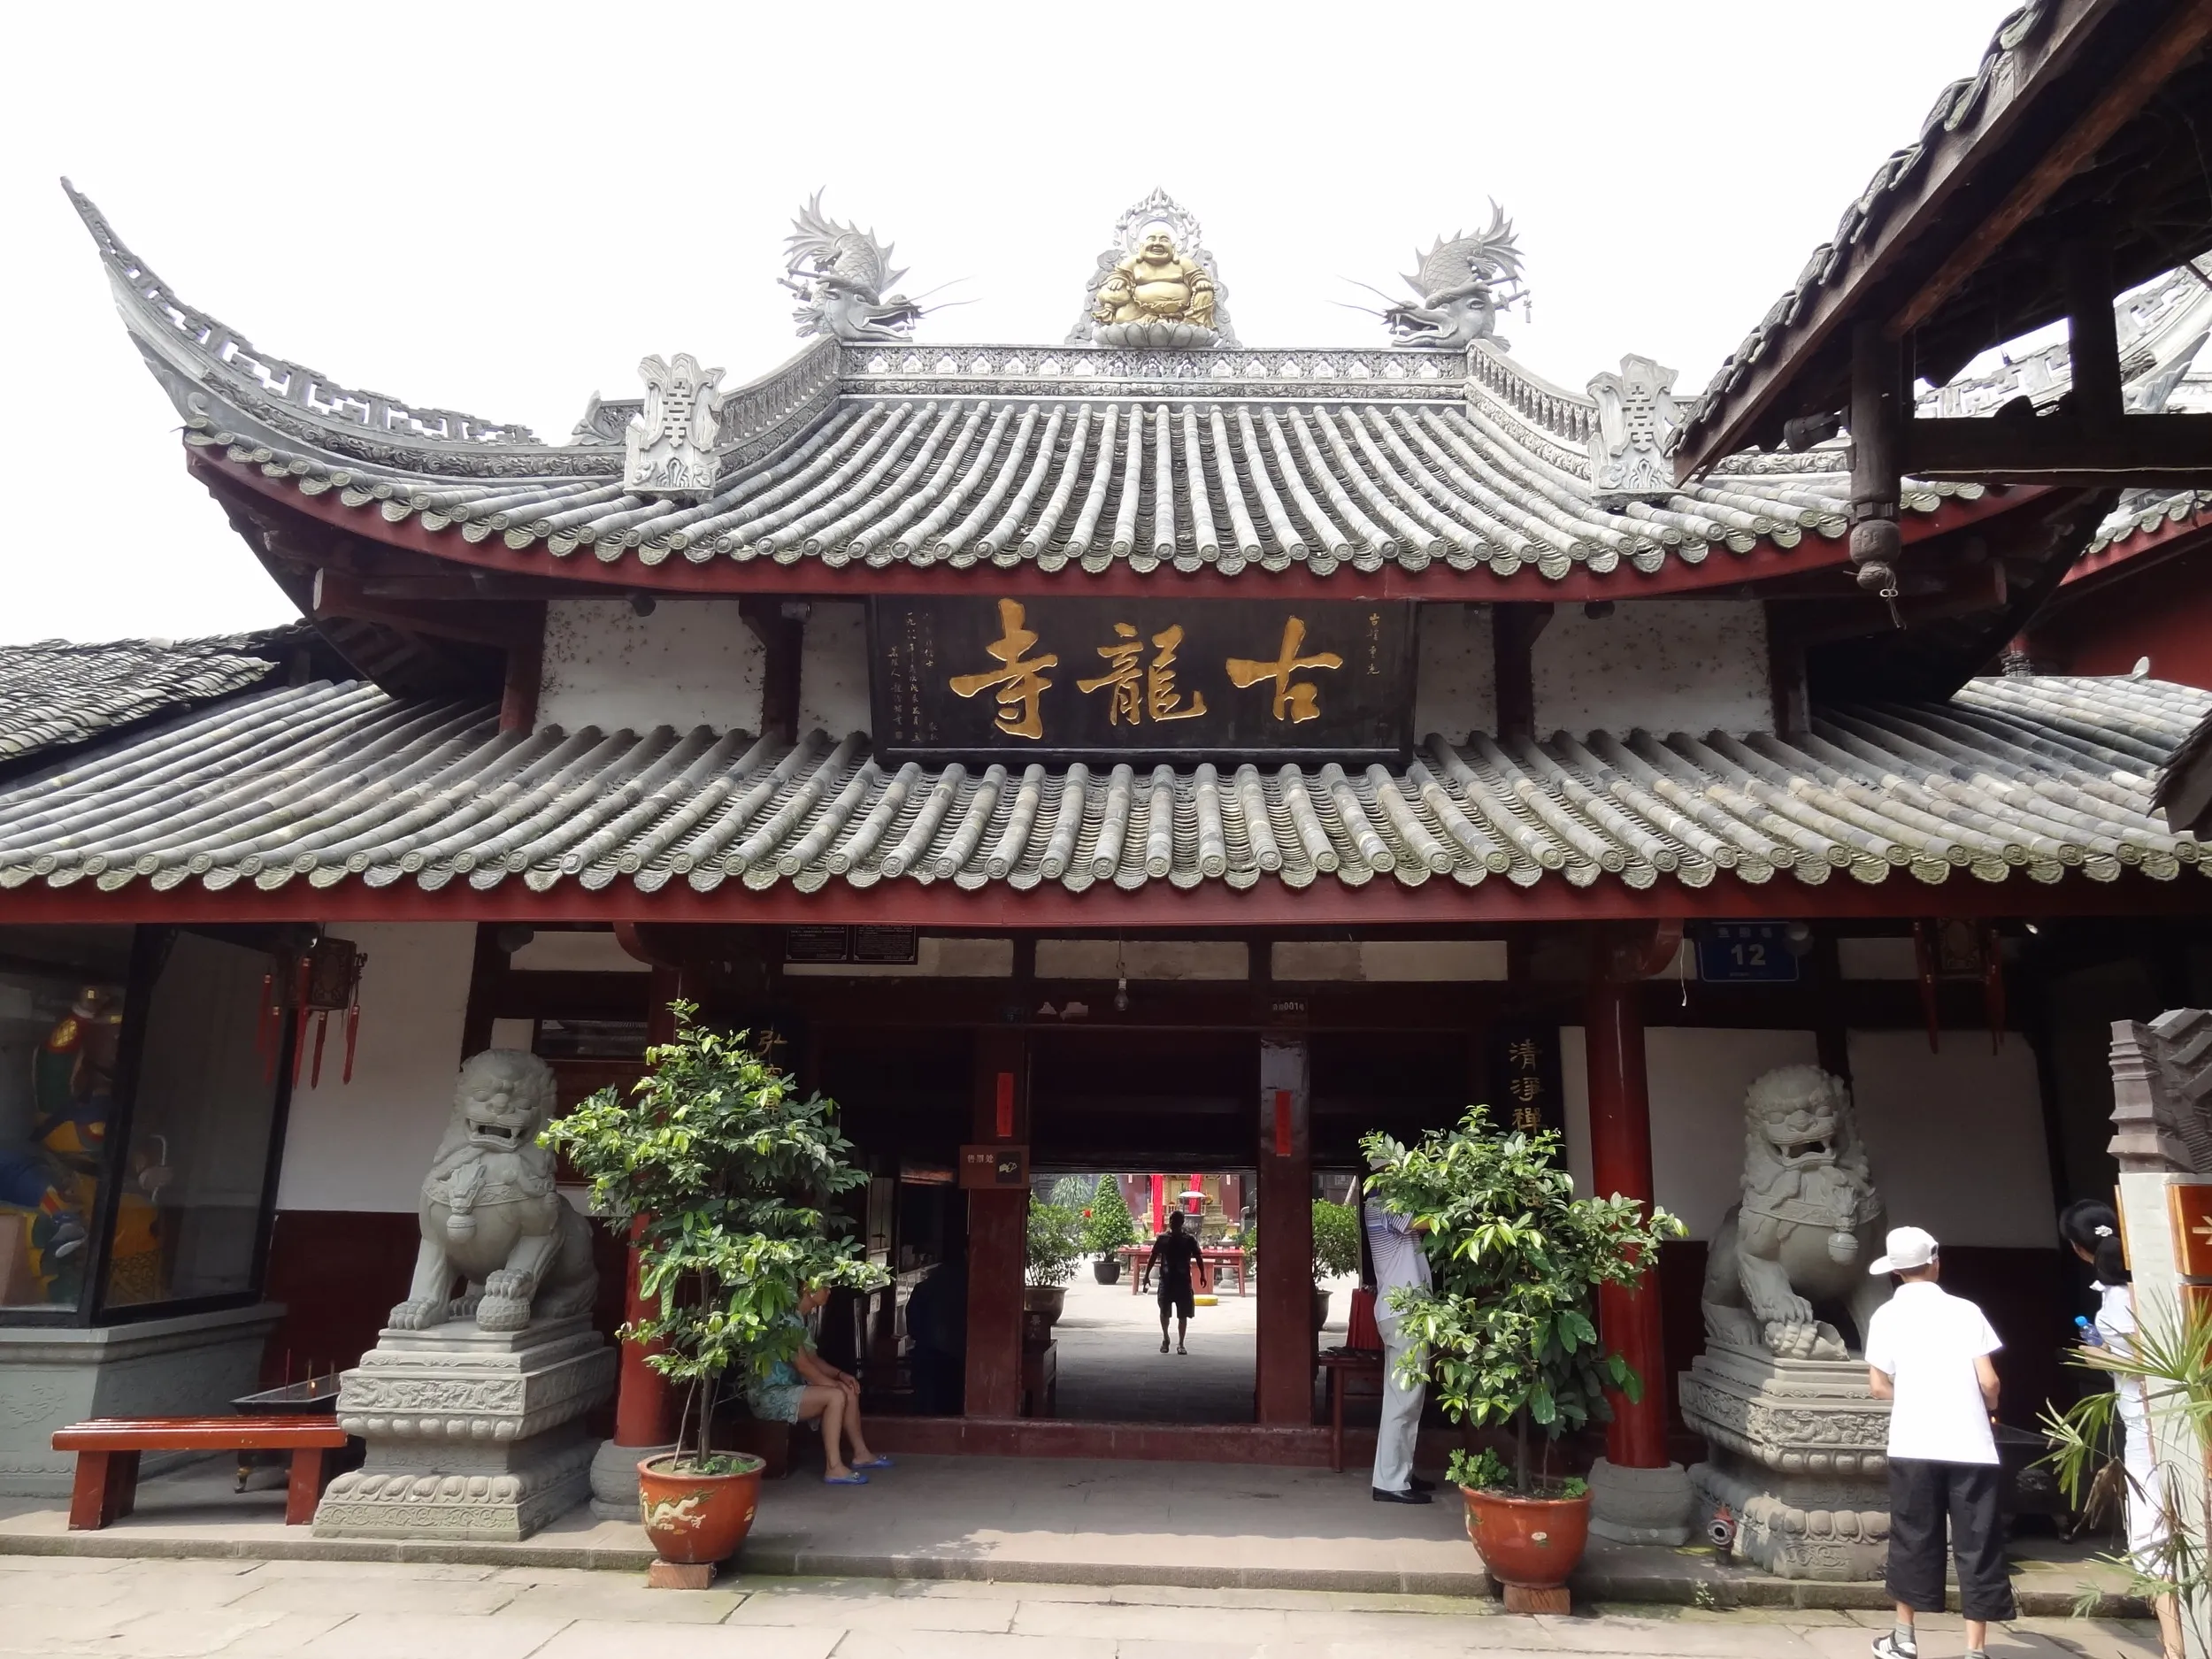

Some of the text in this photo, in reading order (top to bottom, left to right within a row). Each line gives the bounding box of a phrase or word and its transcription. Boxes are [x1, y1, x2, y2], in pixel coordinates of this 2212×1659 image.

[949, 597, 1344, 740] 古龍寺
[1731, 943, 1766, 965] 12
